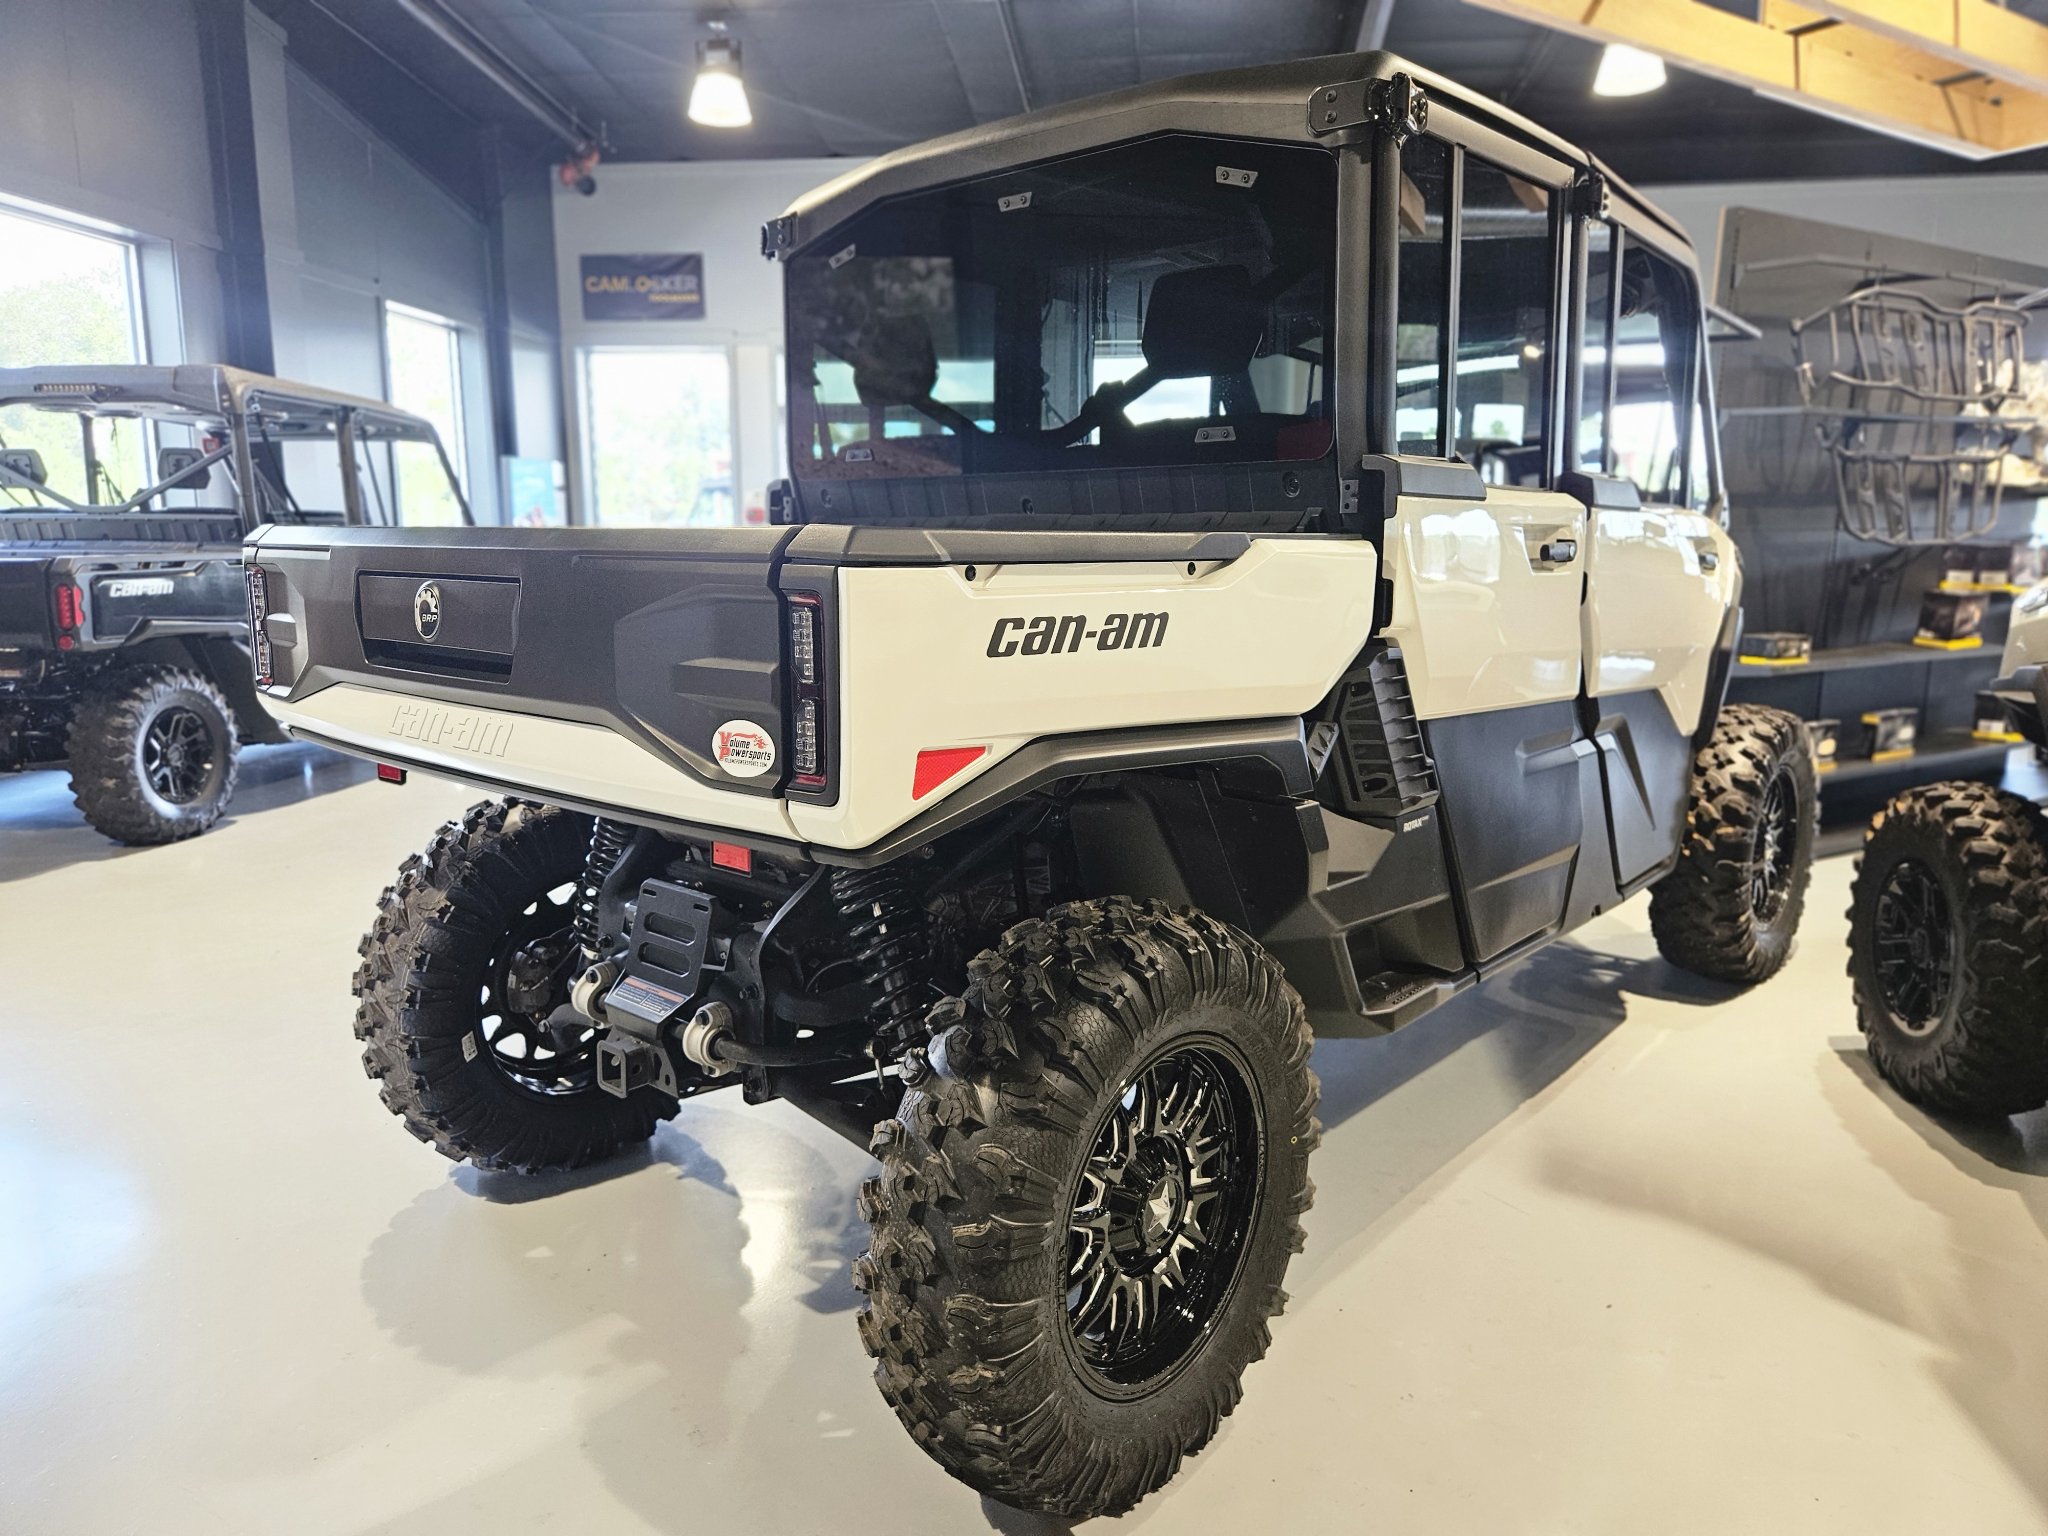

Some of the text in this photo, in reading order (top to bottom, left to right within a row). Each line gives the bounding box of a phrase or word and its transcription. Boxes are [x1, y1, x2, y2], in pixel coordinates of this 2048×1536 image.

[421, 613, 438, 622] BRP
[985, 611, 1170, 658] can-am
[387, 703, 514, 758] can-am
[718, 731, 751, 749] Volume
[718, 746, 772, 761] Powersports
